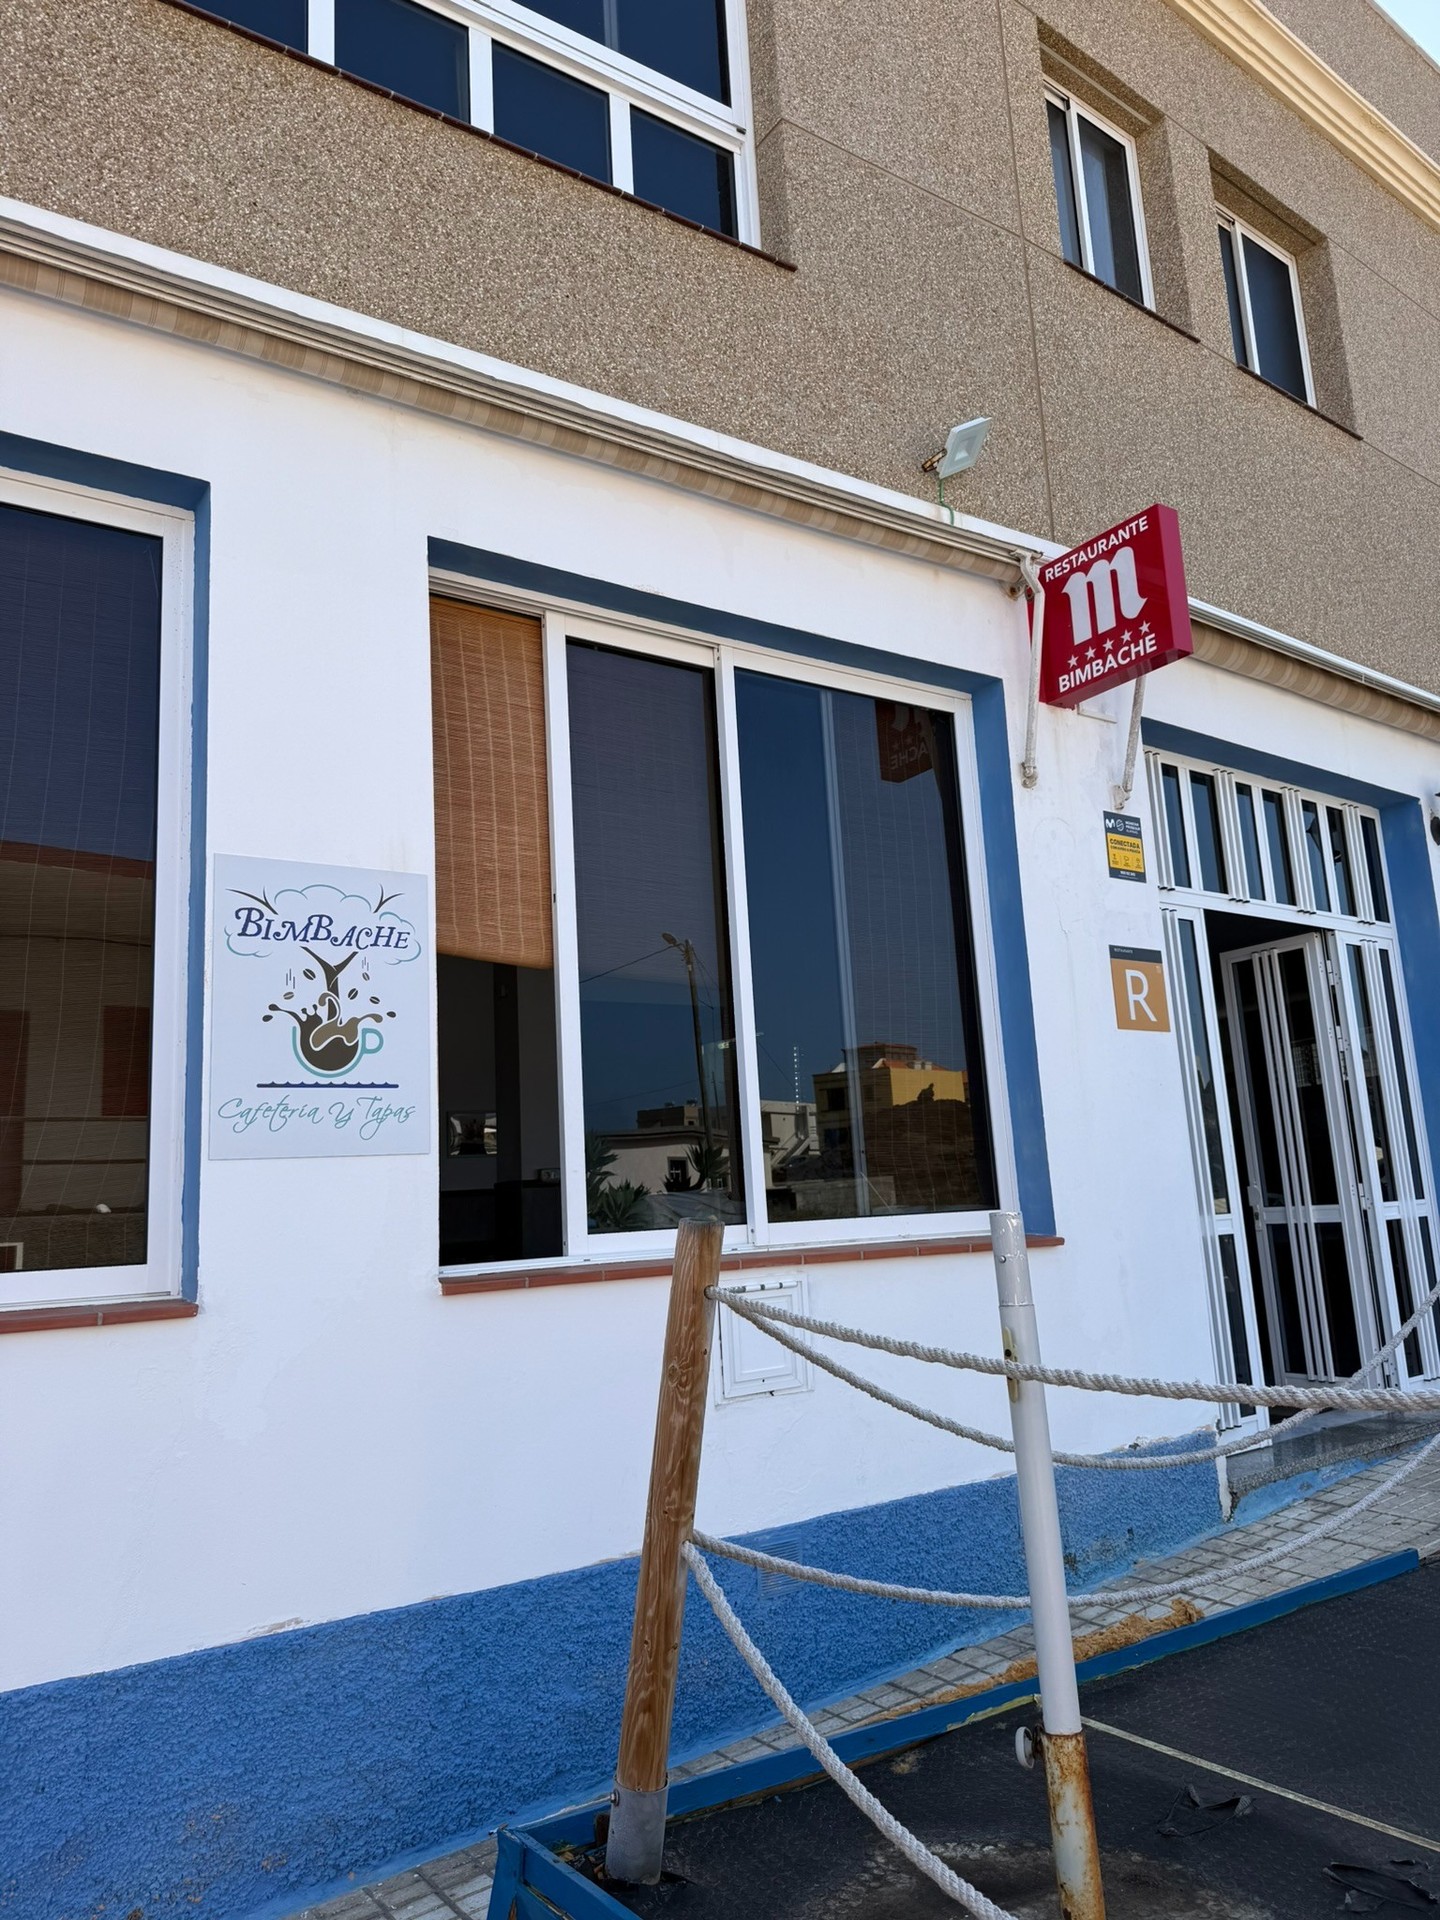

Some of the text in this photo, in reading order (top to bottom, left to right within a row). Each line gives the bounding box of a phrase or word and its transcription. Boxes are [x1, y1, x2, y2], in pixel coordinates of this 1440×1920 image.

[1045, 515, 1150, 583] RESTAURANTE
[1058, 633, 1158, 693] BIMBACHE
[1125, 969, 1158, 1022] R
[356, 1095, 416, 1141] Tapas
